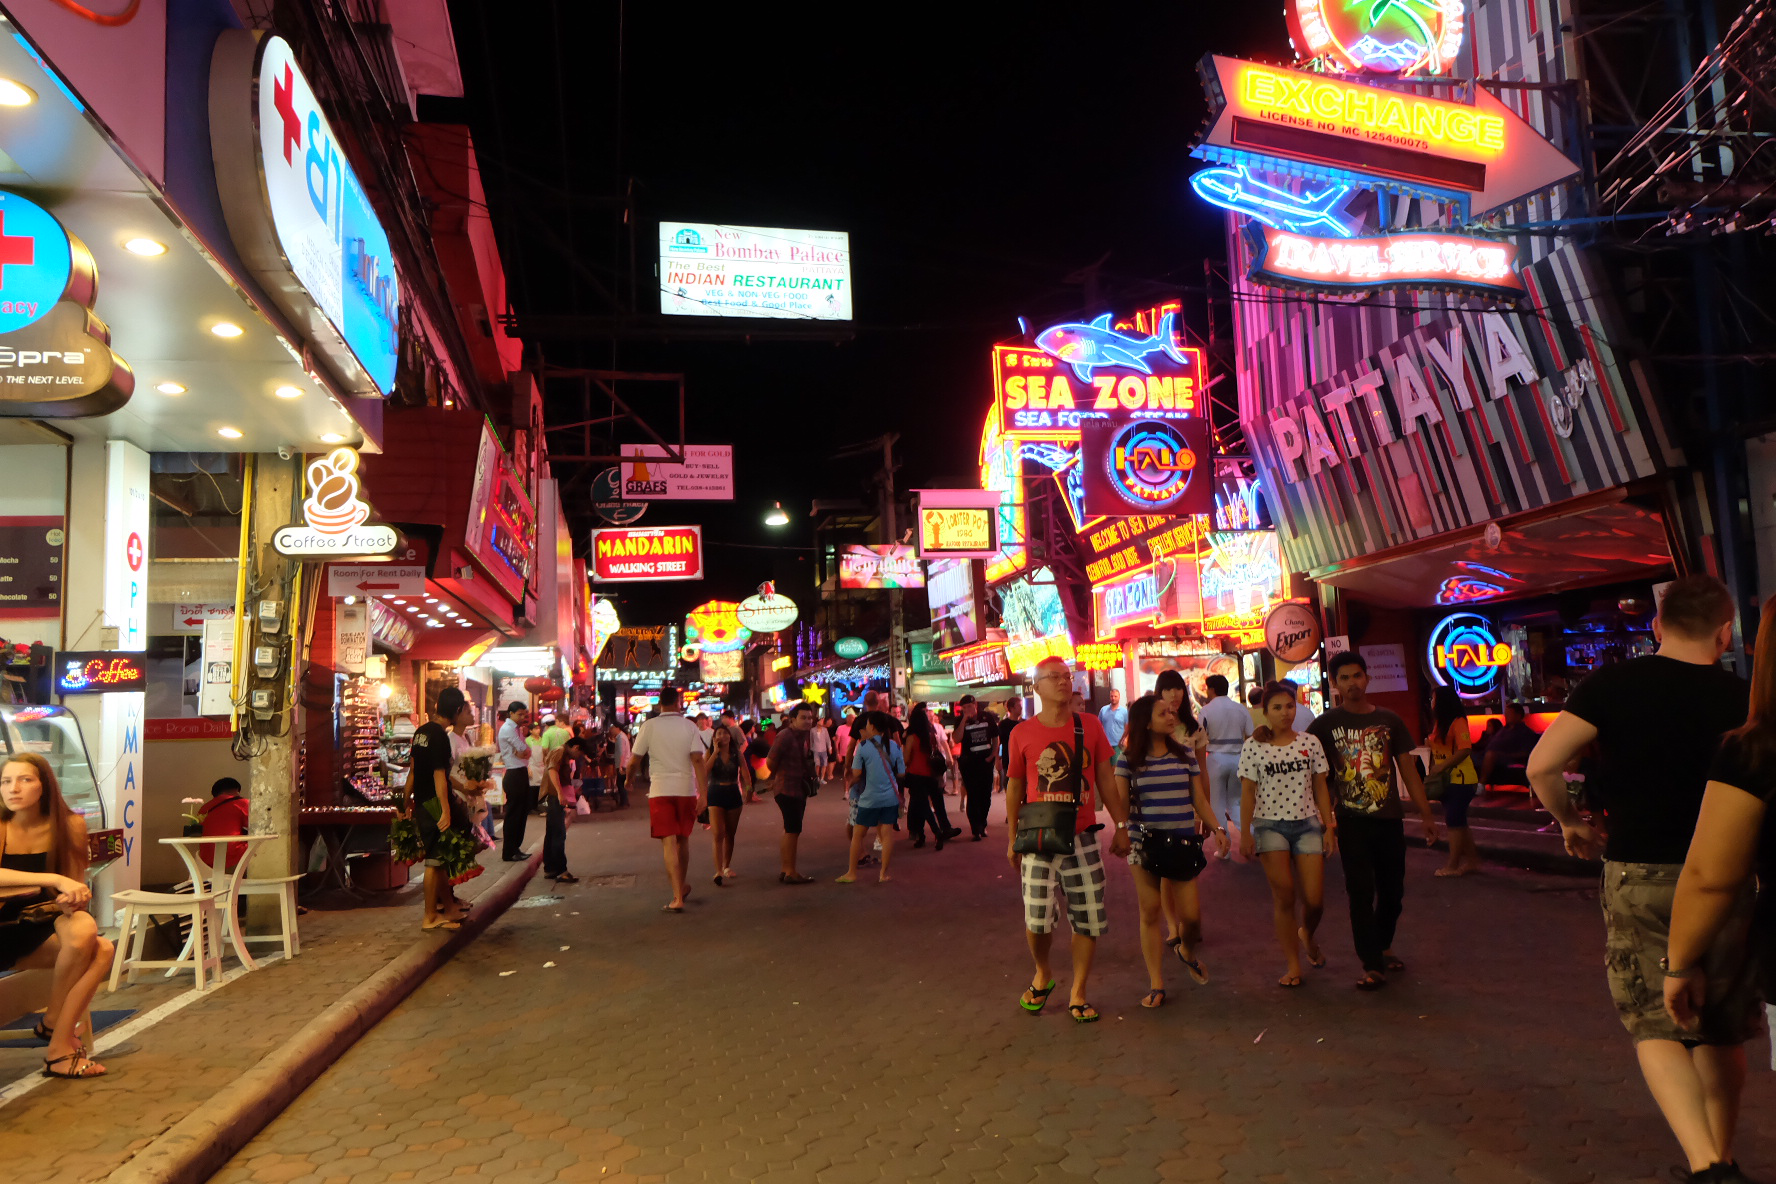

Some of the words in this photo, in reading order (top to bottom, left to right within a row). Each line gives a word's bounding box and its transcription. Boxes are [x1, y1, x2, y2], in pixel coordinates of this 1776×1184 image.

[1244, 69, 1505, 149] EXCHANGE
[1260, 109, 1314, 129] LICENSE
[1317, 120, 1335, 132] NO
[1341, 126, 1360, 137] MC
[1364, 130, 1429, 150] 125490075
[714, 229, 742, 240] New
[715, 242, 782, 265] Bombay
[790, 245, 844, 263] Palace
[1272, 234, 1387, 277] TRAVEL
[1386, 238, 1508, 278] SERVICE
[667, 261, 691, 270] The
[697, 262, 726, 272] Best
[667, 272, 726, 286] INDIAN
[733, 274, 845, 291] RESTAURANT
[762, 300, 782, 309] Good
[789, 301, 813, 309] Place
[783, 292, 808, 300] FOOD
[6, 375, 25, 384] THE
[28, 376, 53, 384] NEXT
[56, 376, 84, 385] LEVEL
[1005, 376, 1075, 410] SEA
[1093, 376, 1195, 410] ZONE
[1270, 306, 1539, 484] PATTAYA
[1015, 411, 1053, 427] SEA
[1115, 447, 1197, 471] HALO
[626, 481, 668, 492] GRAFS
[1125, 477, 1186, 500] PATTAYA
[945, 511, 970, 530] LOBSTER
[972, 514, 989, 533] POT
[279, 534, 337, 549] Coffee
[342, 533, 394, 548] Street
[1089, 524, 1121, 554] WELCOME
[1116, 519, 1130, 542] TO
[1128, 515, 1147, 536] SEA
[598, 536, 694, 559] MANDARIN
[333, 569, 359, 578] Room
[361, 569, 375, 578] For
[377, 569, 398, 578] Rent
[400, 569, 422, 580] Daily
[609, 562, 655, 574] WALKING
[656, 561, 687, 573] STREET
[1284, 618, 1305, 628] Chang
[1275, 627, 1313, 652] Export
[1330, 639, 1342, 649] NO
[1436, 642, 1512, 669] HALO
[84, 658, 140, 683] Coffee
[602, 669, 676, 682] ALCATRAZ
[166, 722, 199, 734] Room
[203, 721, 229, 736] Daily
[1264, 758, 1311, 776] MICKEY
